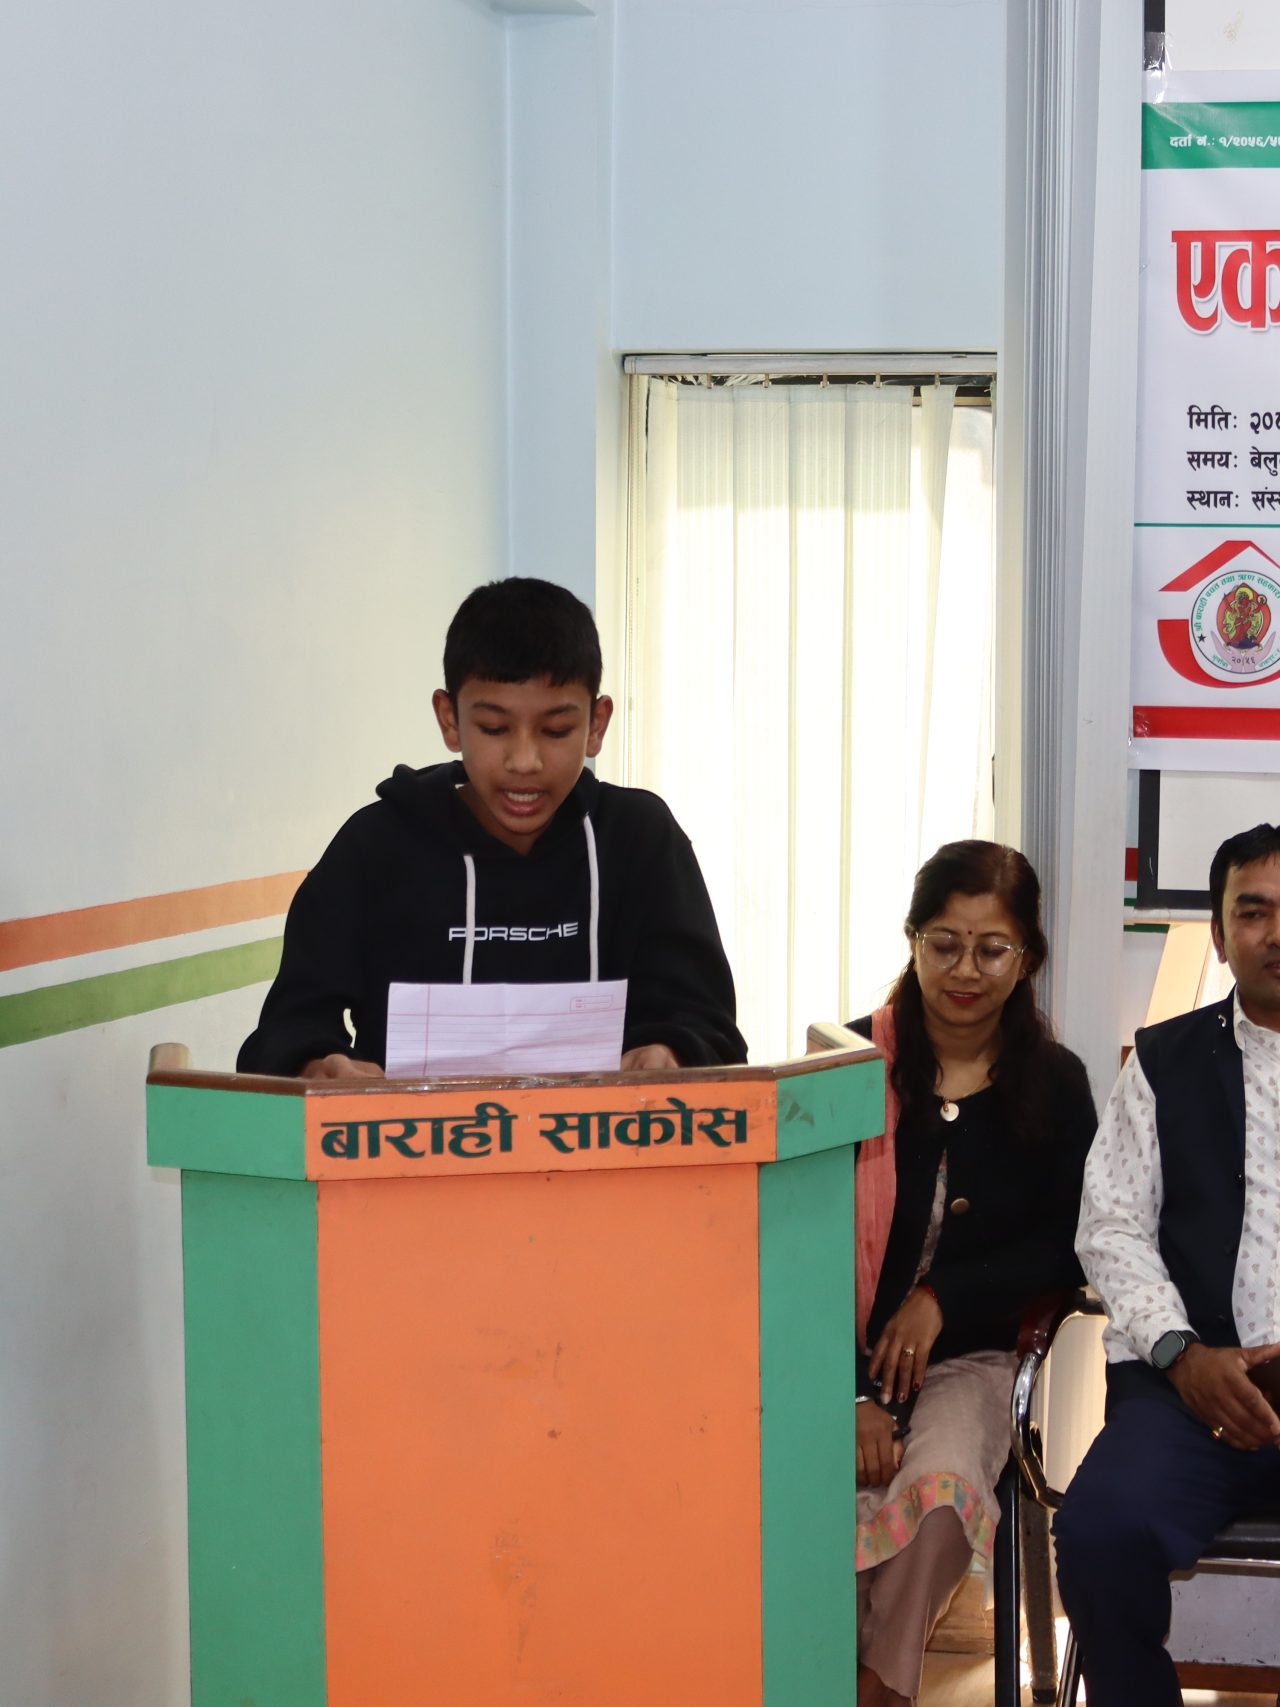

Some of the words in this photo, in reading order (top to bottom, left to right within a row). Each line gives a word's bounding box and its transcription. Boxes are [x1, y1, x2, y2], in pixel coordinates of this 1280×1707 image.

[1187, 404, 1238, 432] मिति:
[1187, 450, 1238, 471] समय:
[1186, 489, 1239, 512] स्थान:
[448, 921, 579, 941] PORSCHE
[321, 1102, 517, 1160] बाराही
[539, 1096, 749, 1154] साकोस
